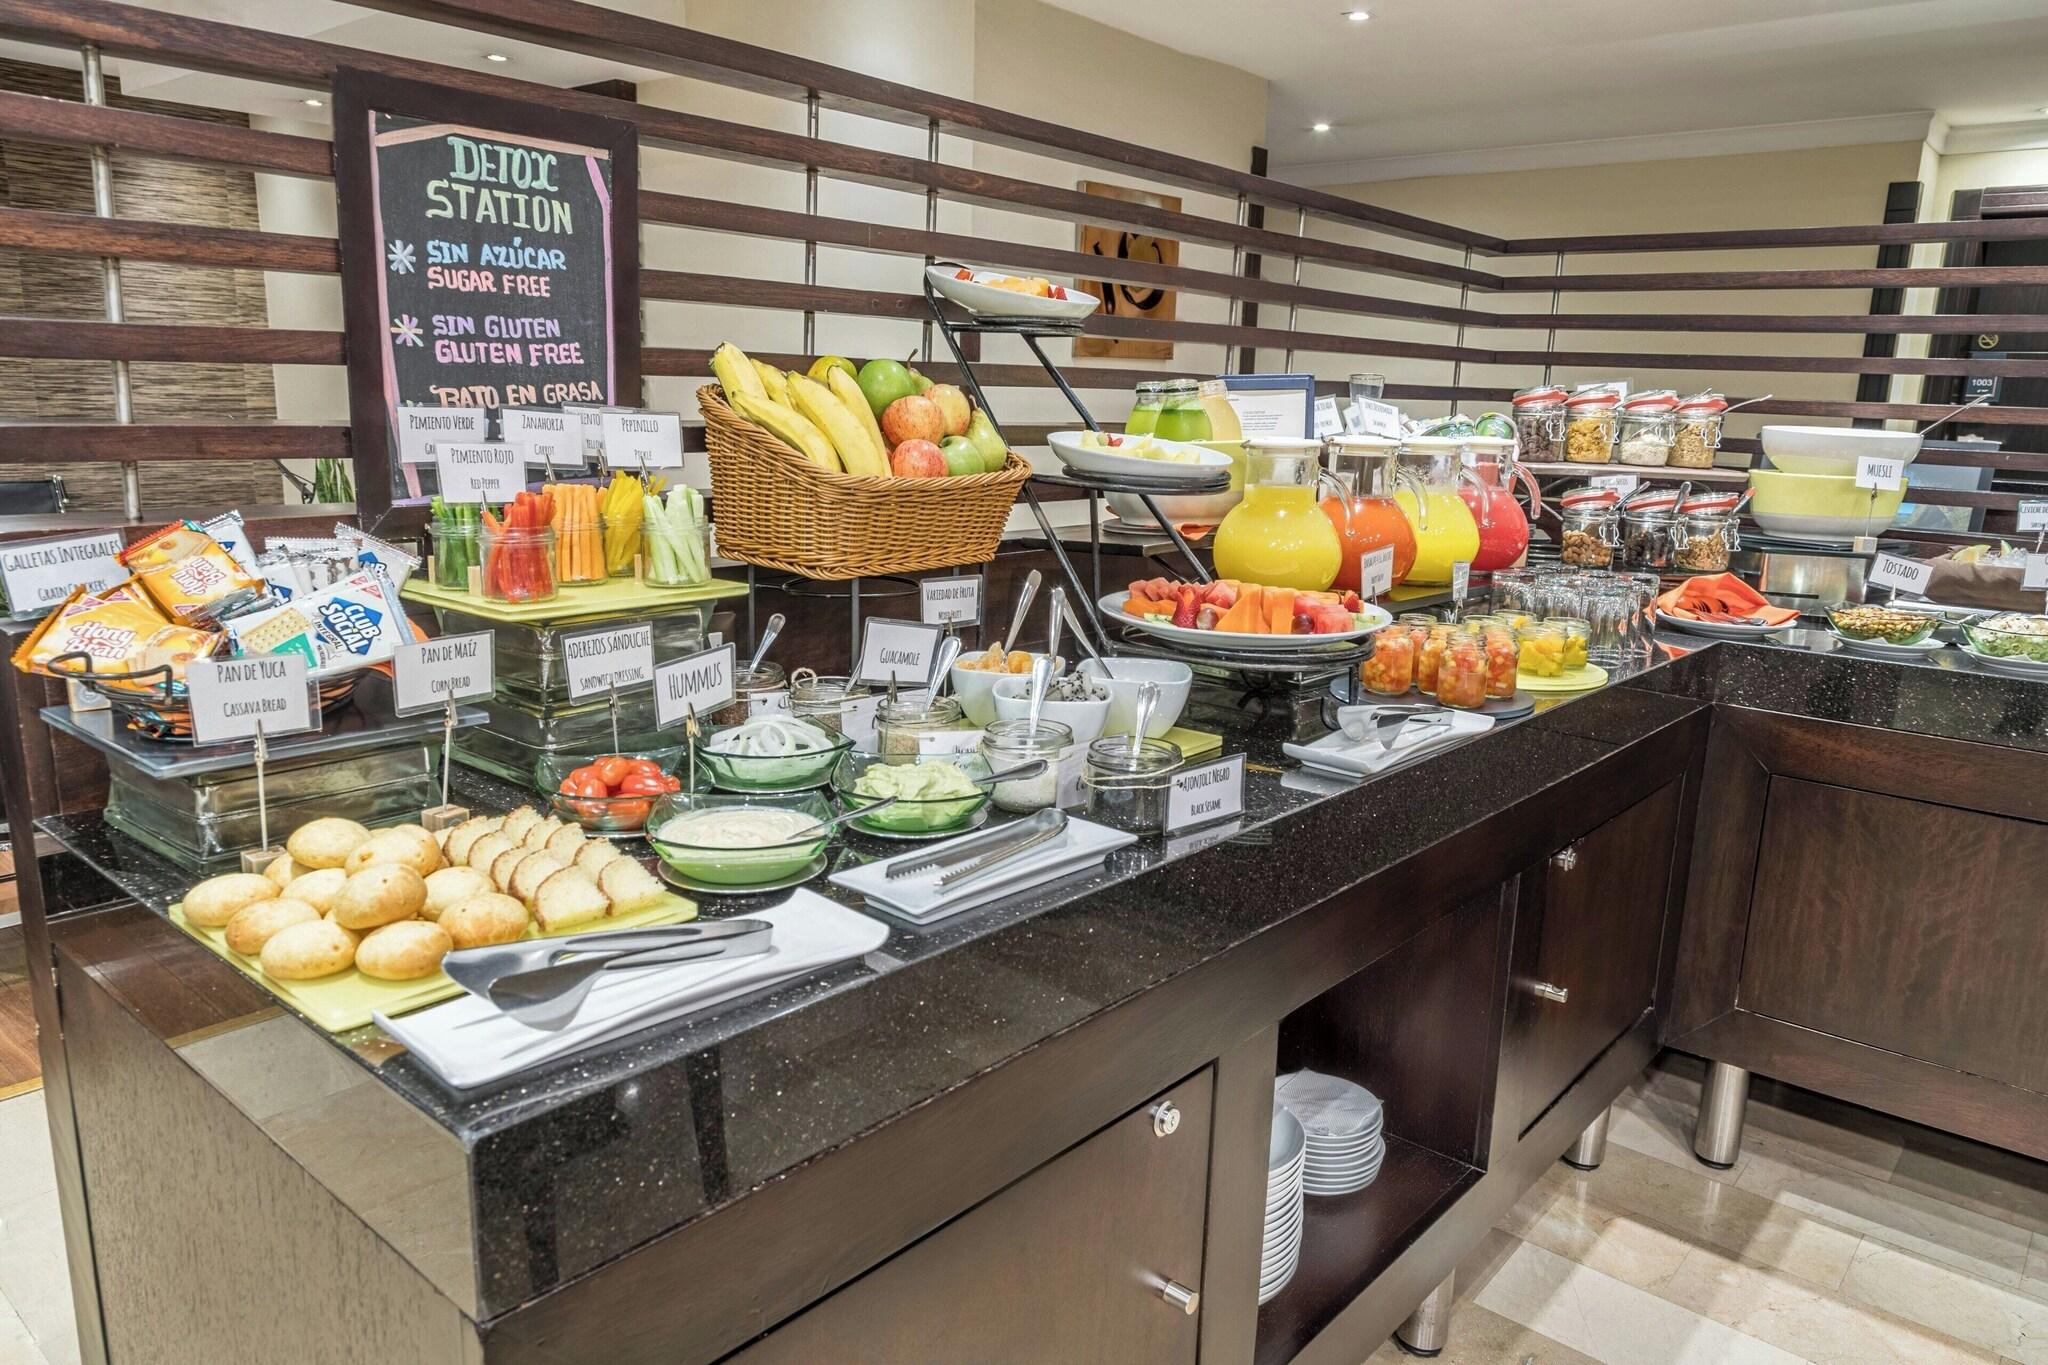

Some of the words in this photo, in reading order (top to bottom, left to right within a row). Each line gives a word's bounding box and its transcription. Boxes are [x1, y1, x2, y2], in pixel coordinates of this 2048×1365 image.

[447, 136, 559, 191] DETOX
[425, 179, 573, 235] STATION
[426, 239, 469, 264] SIN
[480, 236, 567, 270] AZÚCAR
[427, 266, 497, 292] SUGAR
[503, 274, 551, 297] FREE
[432, 314, 475, 336] SIN
[484, 315, 561, 339] GLUTEN
[435, 339, 524, 364] GLUTEN
[529, 342, 585, 367] FREE
[506, 384, 536, 406] EN
[543, 381, 604, 404] GRASA
[1972, 378, 1993, 387] 1003
[409, 414, 452, 431] PIMIENTO
[453, 415, 475, 430] VERDE
[522, 414, 565, 432] ZANAHORIA
[621, 417, 659, 433] PEPINILLO
[450, 447, 493, 464] PIMIENTO
[494, 448, 514, 465] ROJO
[1867, 463, 1893, 479] MUESLI
[3, 548, 57, 572] GALLETAS
[56, 540, 121, 563] INTEGRALES
[190, 556, 226, 586] Bran
[1882, 559, 1919, 581] TOSTADO
[38, 585, 67, 601] GRAIN
[953, 587, 959, 599] DE
[960, 586, 975, 598] FRUTA
[318, 601, 370, 654] SOCIAL
[343, 602, 382, 640] CLUB
[71, 621, 137, 648] Hony
[314, 620, 344, 650] INTEGRAL
[567, 636, 607, 660] ADEREZOS
[607, 630, 650, 653] SÁNDUCHE
[64, 637, 128, 660] Bran
[421, 647, 440, 664] PAN
[442, 645, 453, 661] DE
[454, 639, 477, 659] MAÍZ
[880, 647, 920, 666] GUACAMOLE
[217, 664, 241, 683] PAN
[244, 664, 257, 680] DE
[259, 661, 287, 679] YUCA
[614, 666, 645, 683] DRESSING
[668, 661, 723, 700] HUMMUS
[431, 679, 450, 693] CORN
[451, 676, 471, 690] BREAD
[223, 700, 261, 717] CASSAVA
[261, 697, 287, 712] BREAD
[1212, 767, 1230, 784] NEGRO
[1191, 802, 1205, 816] BLACK
